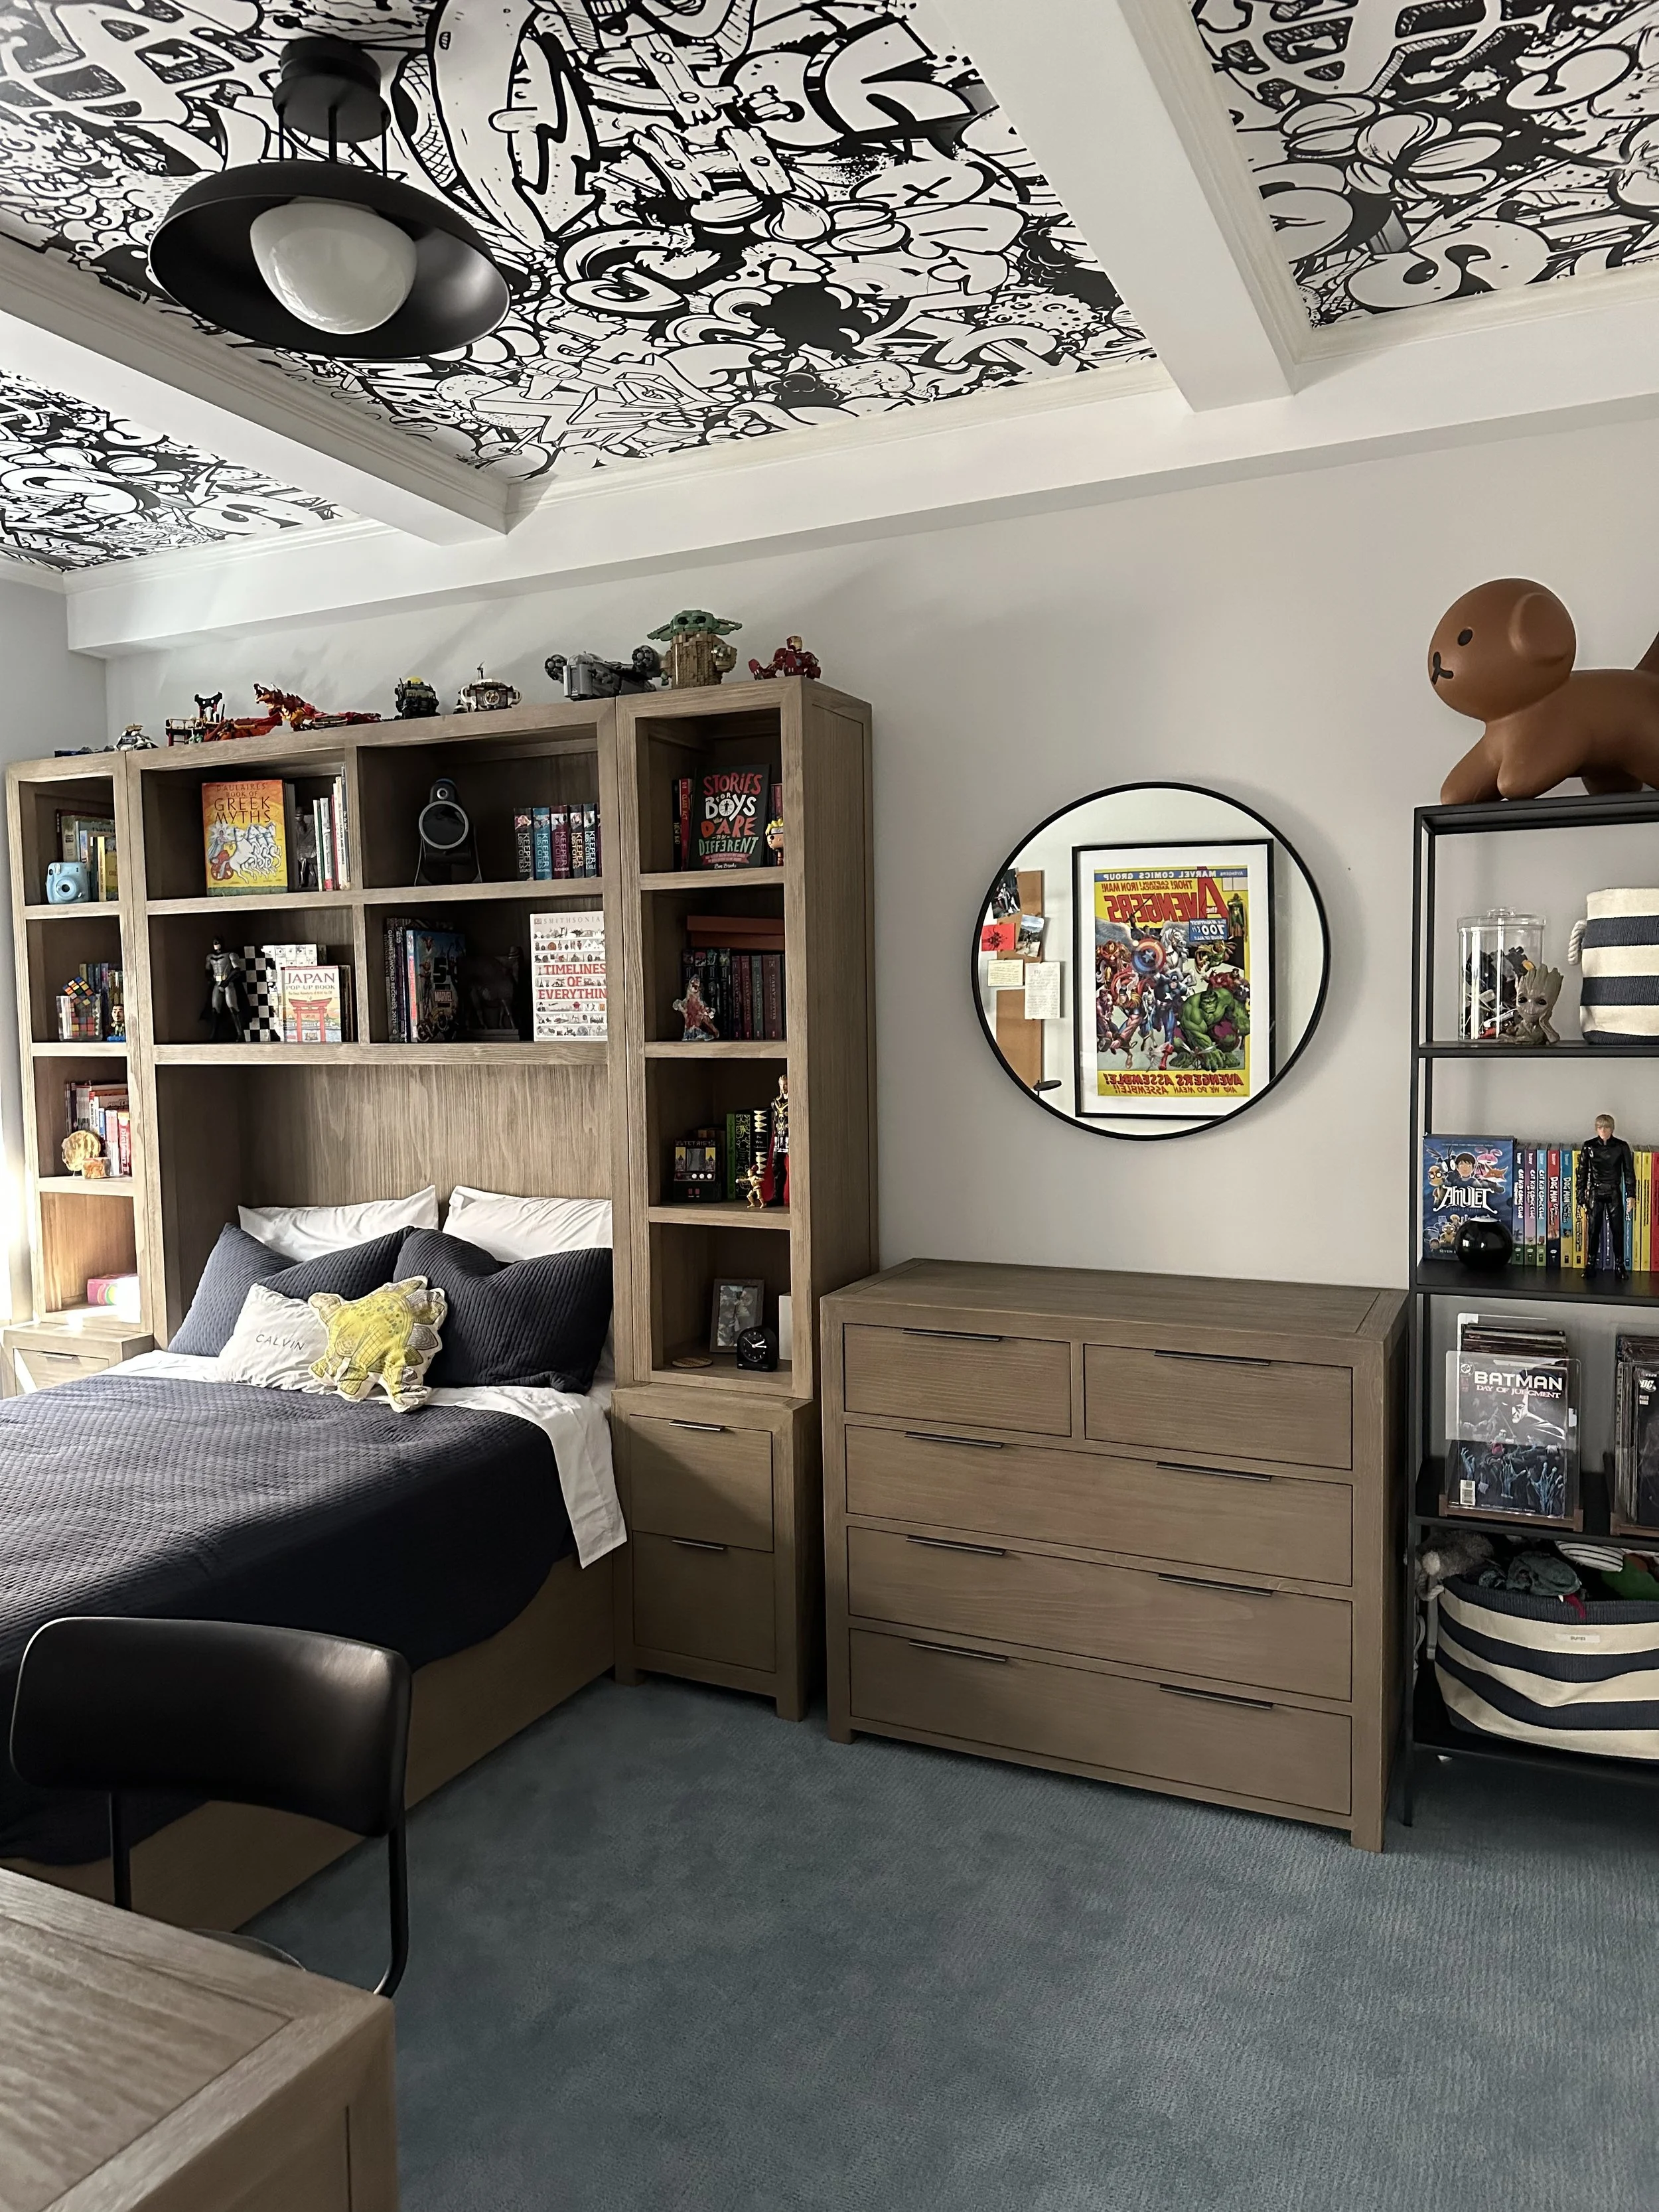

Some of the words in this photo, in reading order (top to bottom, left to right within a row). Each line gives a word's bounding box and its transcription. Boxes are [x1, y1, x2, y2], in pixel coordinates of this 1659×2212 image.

[703, 773, 762, 796] STORIES
[214, 796, 270, 811] GREEK
[716, 792, 731, 802] FOR
[705, 794, 757, 822] BOYS
[215, 810, 271, 824] MYTHS
[701, 815, 758, 838] DARE
[698, 837, 760, 856] DIFFERENT
[544, 964, 606, 975] TIMELINES
[285, 973, 335, 984] JAPAN
[567, 976, 582, 987] OF
[435, 991, 453, 1002] MARVEL
[538, 988, 607, 999] EVERYTHIN
[1550, 1176, 1558, 1190] DOG
[1563, 1177, 1571, 1190] DOG
[1433, 1185, 1498, 1214] AMULET
[1550, 1190, 1558, 1203] MAN
[256, 1334, 305, 1351] CALVIN
[1461, 1364, 1471, 1372] DC
[1474, 1371, 1563, 1391] BATMAN
[1640, 1380, 1654, 1388] DC
[1511, 1388, 1561, 1398] JUDGMENT
